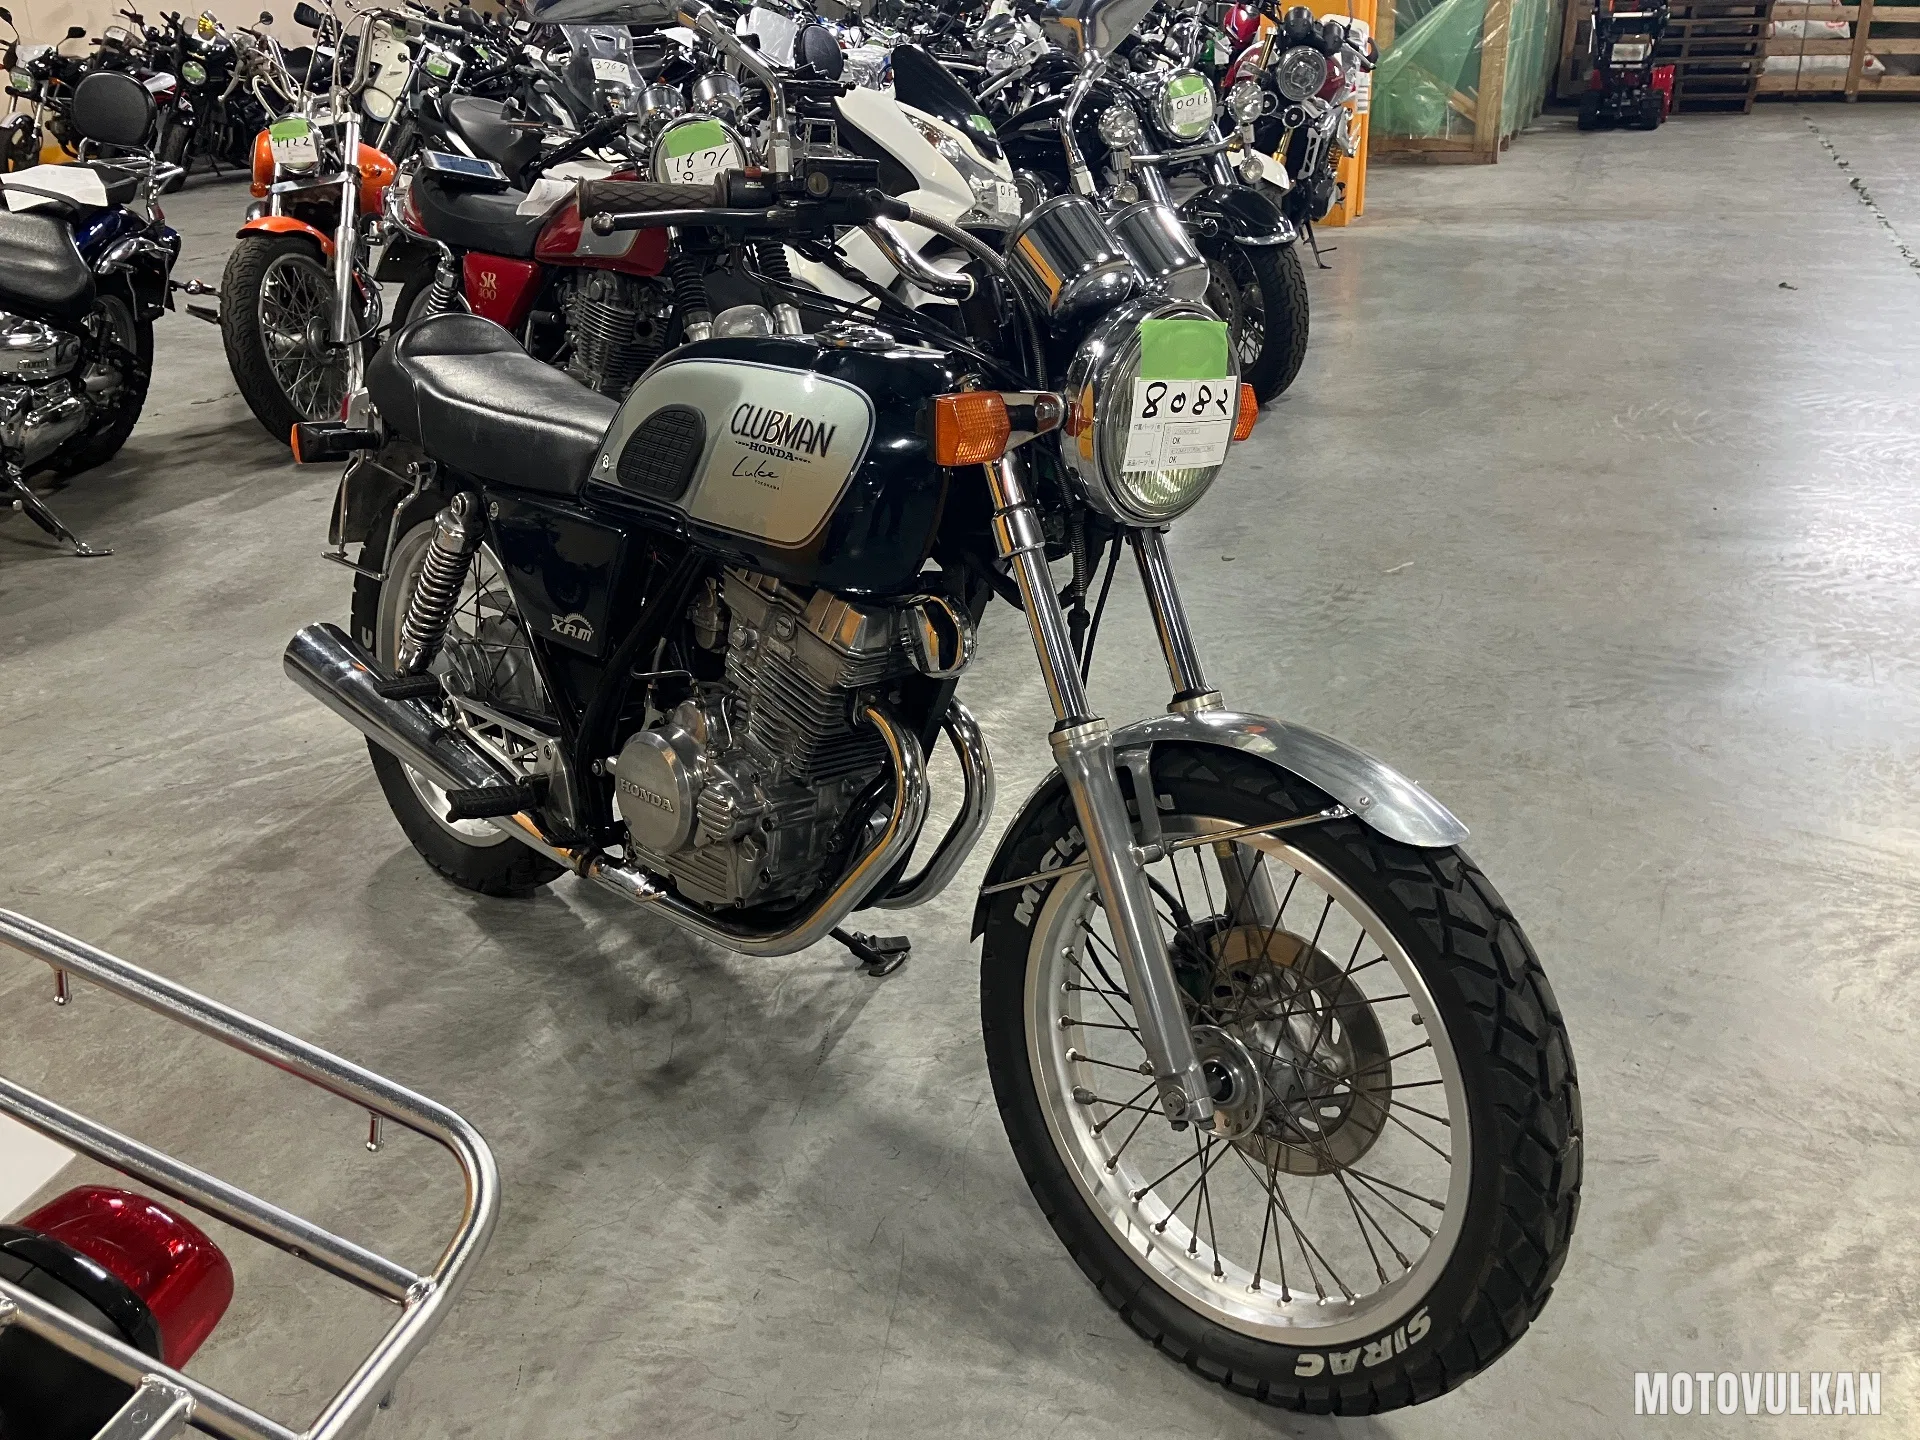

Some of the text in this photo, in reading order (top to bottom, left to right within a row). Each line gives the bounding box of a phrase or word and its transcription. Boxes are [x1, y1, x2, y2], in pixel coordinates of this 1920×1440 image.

[593, 60, 626, 73] 3769
[1176, 91, 1208, 110] 0016
[676, 148, 729, 173] 1671
[479, 271, 497, 290] SR
[1142, 381, 1228, 419] 8082
[730, 403, 837, 459] CLUBMAN
[748, 441, 795, 462] HONDA
[620, 778, 675, 813] HONDA
[1294, 1305, 1432, 1378] SIRAC
